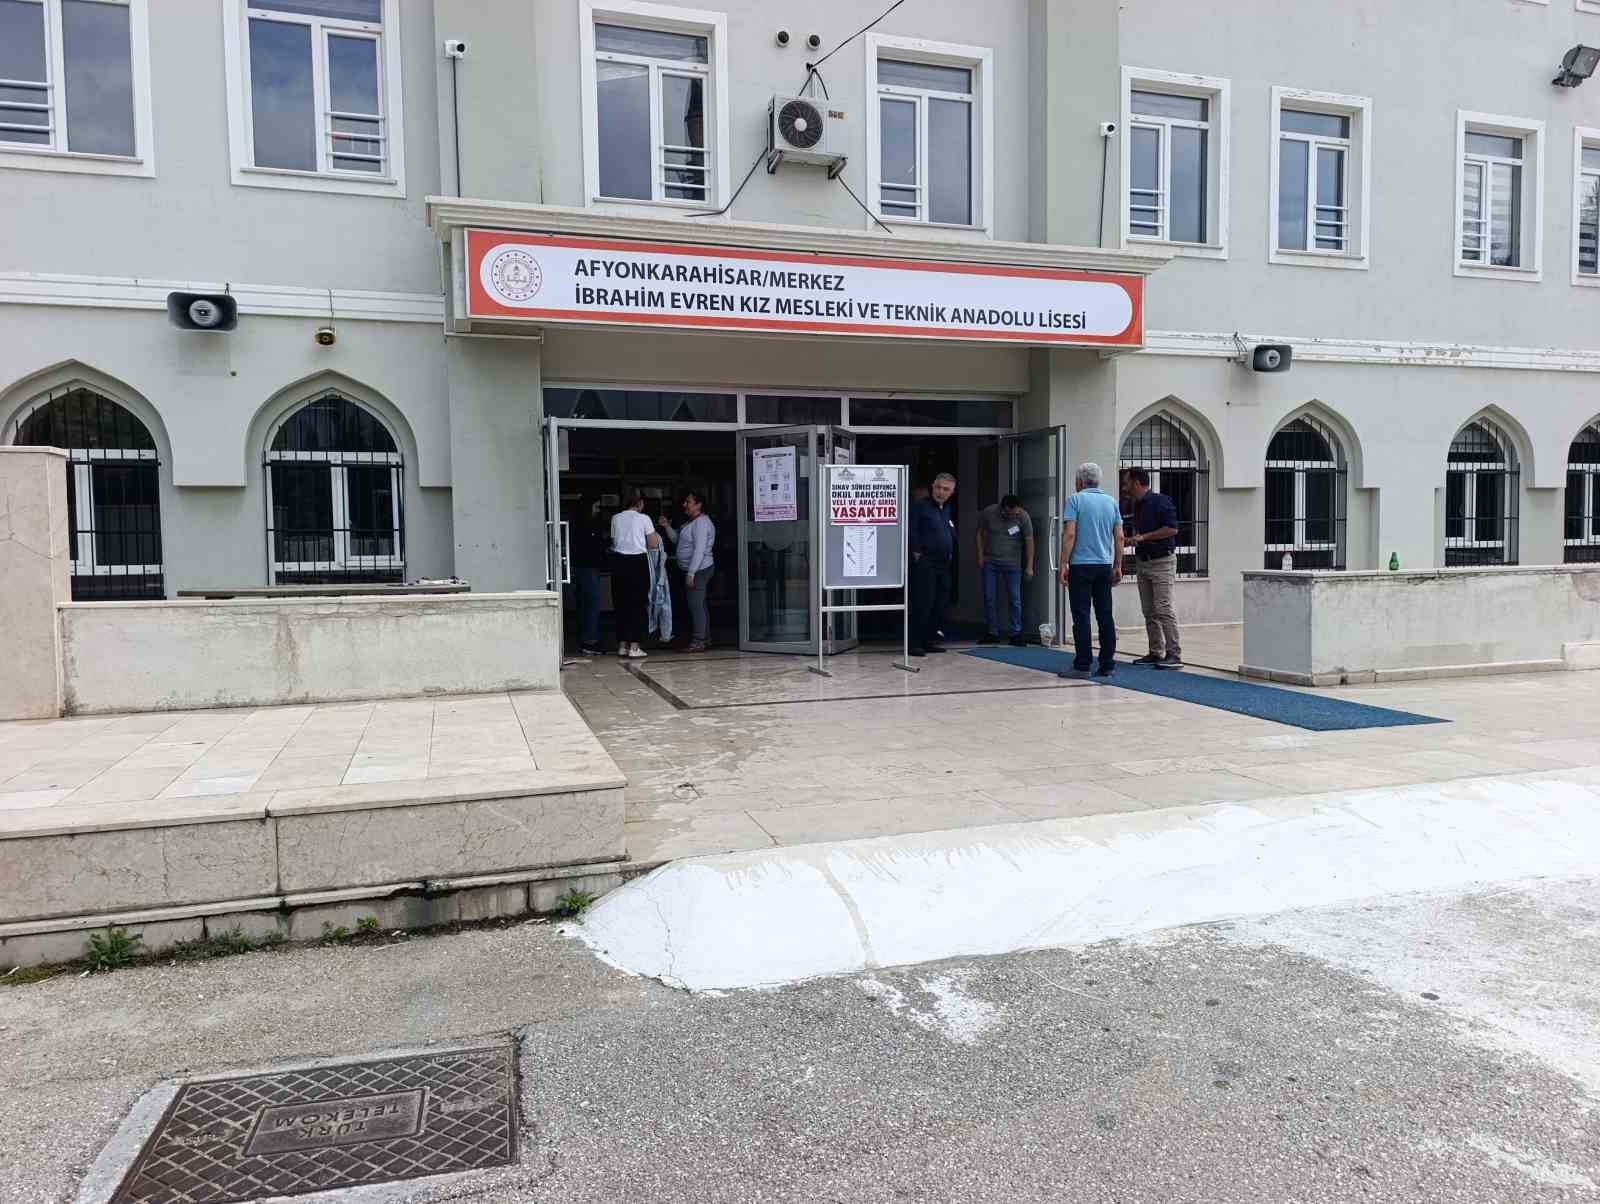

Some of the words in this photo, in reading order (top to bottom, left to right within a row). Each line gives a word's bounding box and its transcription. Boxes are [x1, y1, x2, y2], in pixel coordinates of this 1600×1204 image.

[575, 259, 845, 291] AFYONKARAHİSAR/MERKEZ
[575, 283, 665, 308] İBRAHİM
[671, 292, 735, 312] EVREN
[740, 296, 771, 314] KIZ
[775, 298, 853, 318] MESLEKİ
[857, 302, 880, 320] VE
[883, 302, 947, 323] TEKNİK
[951, 307, 1035, 328] ANADOLU
[1039, 310, 1087, 330] LİSESİ
[832, 507, 897, 517] YASAKTIR
[274, 1105, 400, 1129] TELEKOM
